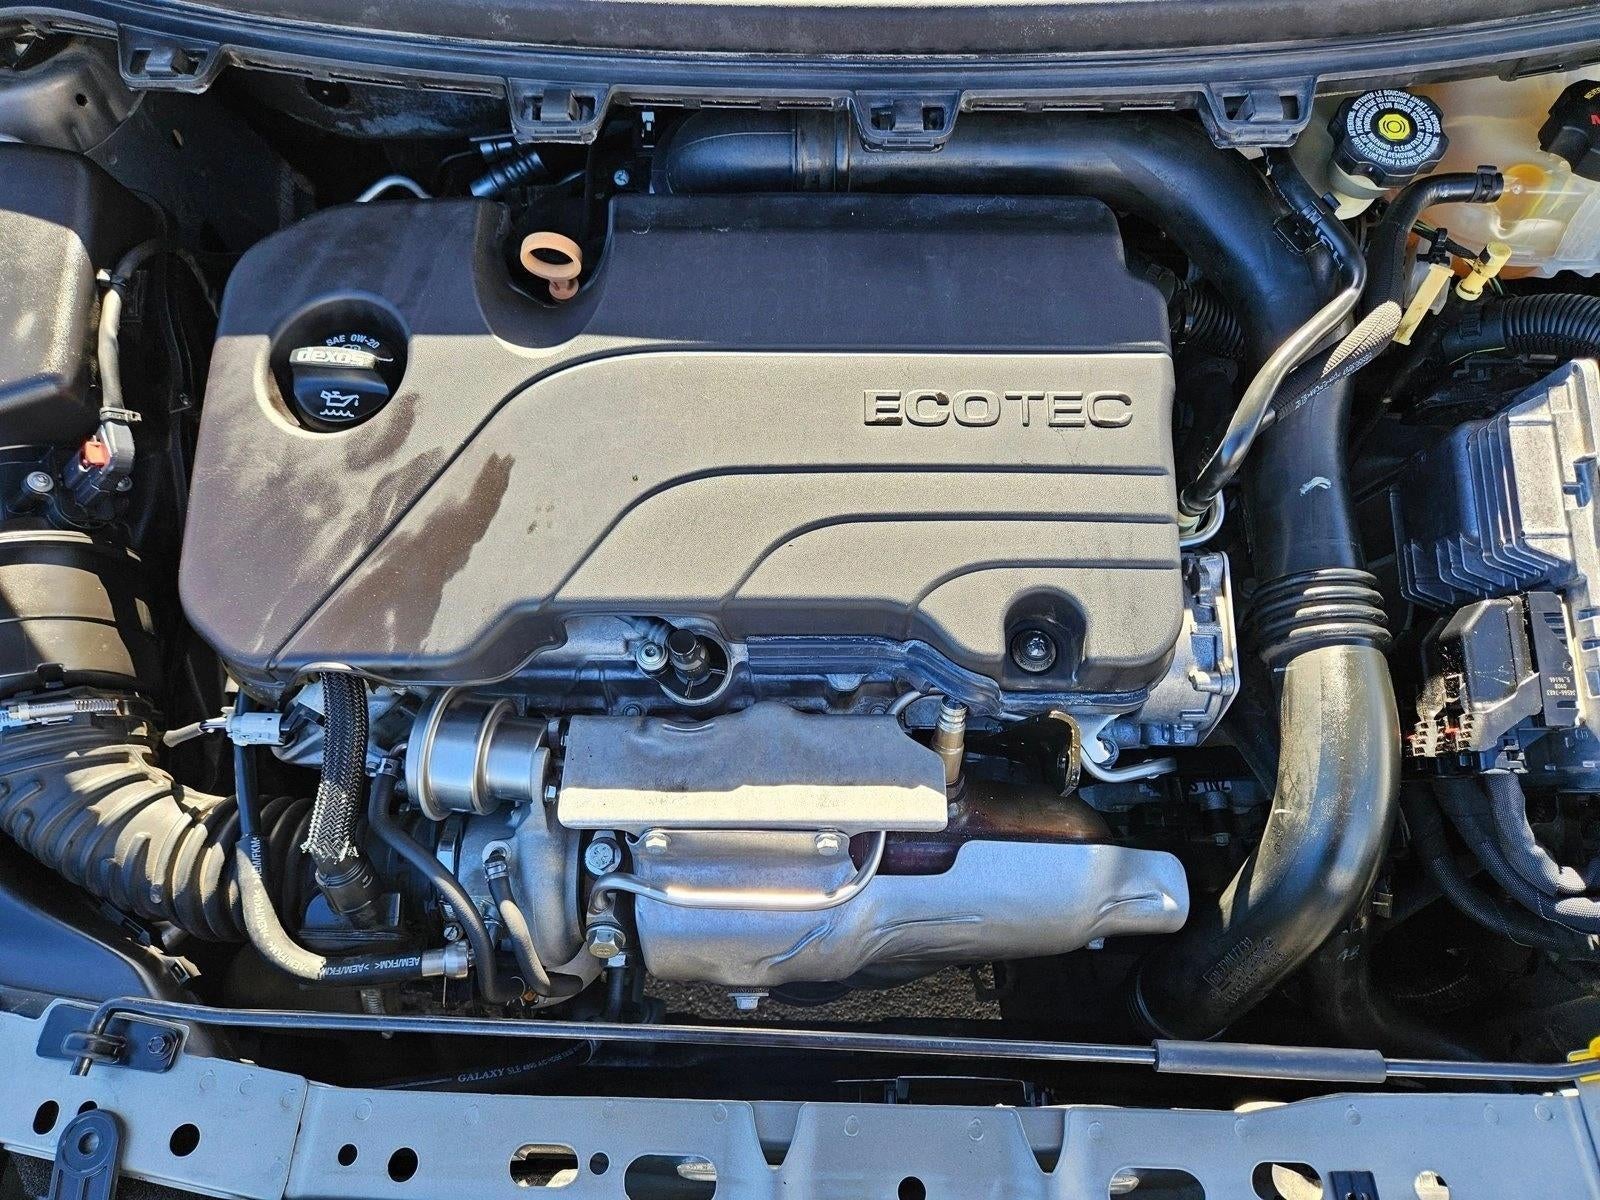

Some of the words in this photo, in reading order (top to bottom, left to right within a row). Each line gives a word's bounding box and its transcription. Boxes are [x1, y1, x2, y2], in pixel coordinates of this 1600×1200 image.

[1384, 90, 1410, 98] BOUCHON
[1410, 96, 1428, 109] AVANT
[1360, 134, 1369, 144] CAP
[1368, 142, 1388, 157] BEFORE
[1394, 144, 1412, 152] CLEAN
[1410, 132, 1425, 148] FILLER
[1362, 148, 1378, 160] FLUID
[1378, 156, 1395, 164] FROM
[1400, 154, 1421, 165] SEALED
[326, 334, 346, 346] SAE
[350, 334, 380, 349] 0W-20
[864, 389, 1133, 428] ECOTEC
[458, 1068, 505, 1083] GALAXY
